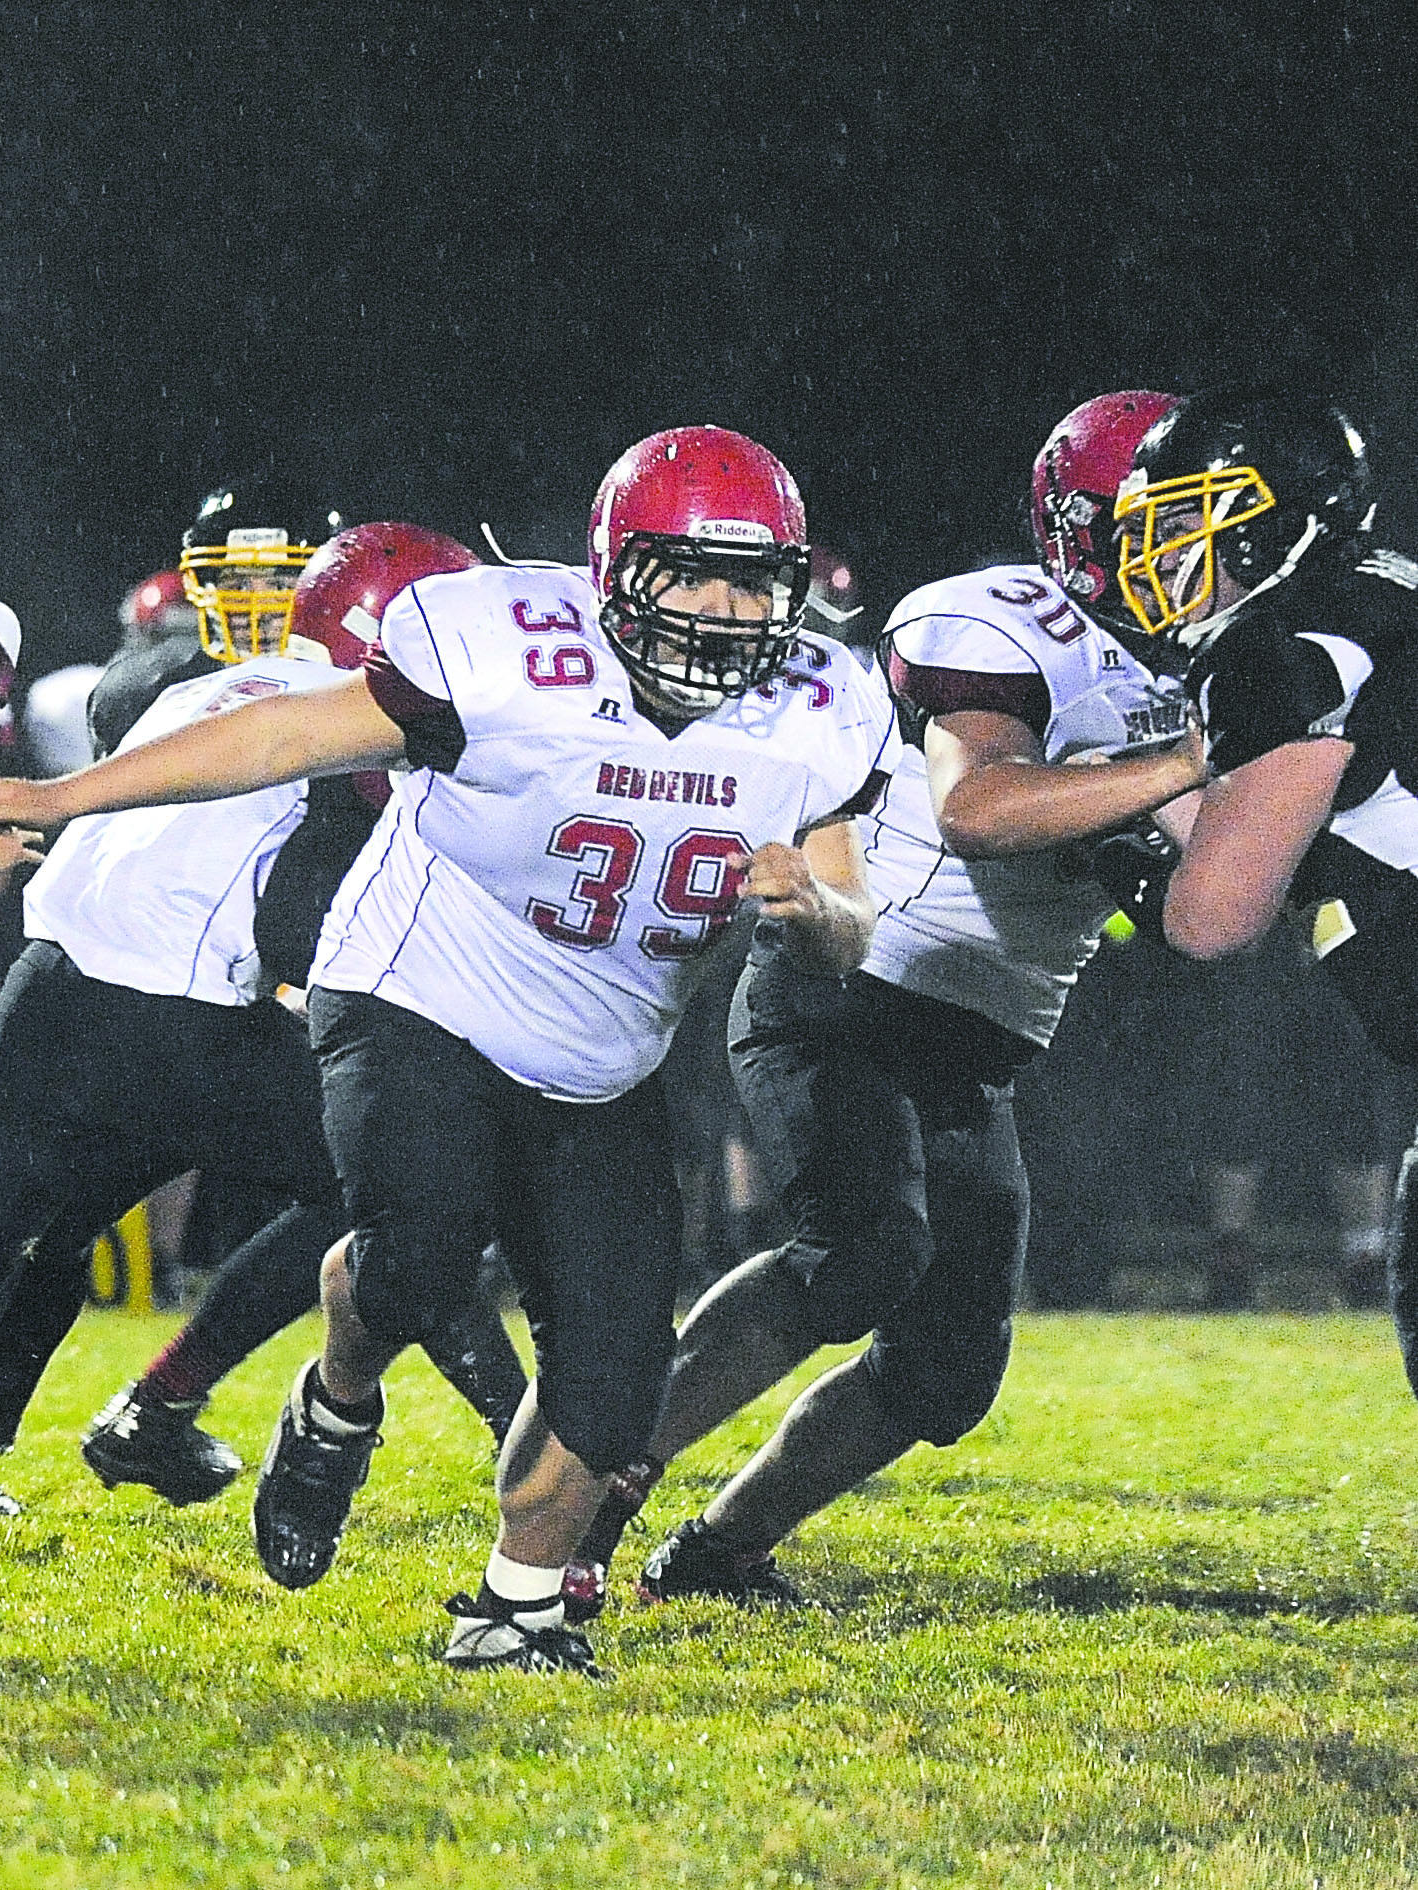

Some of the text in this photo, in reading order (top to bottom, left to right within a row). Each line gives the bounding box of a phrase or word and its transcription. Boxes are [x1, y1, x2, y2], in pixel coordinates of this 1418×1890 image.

[714, 523, 756, 537] Riddell
[509, 599, 599, 690] 39
[596, 762, 738, 808] RED DEVILS
[524, 813, 756, 961] 39
